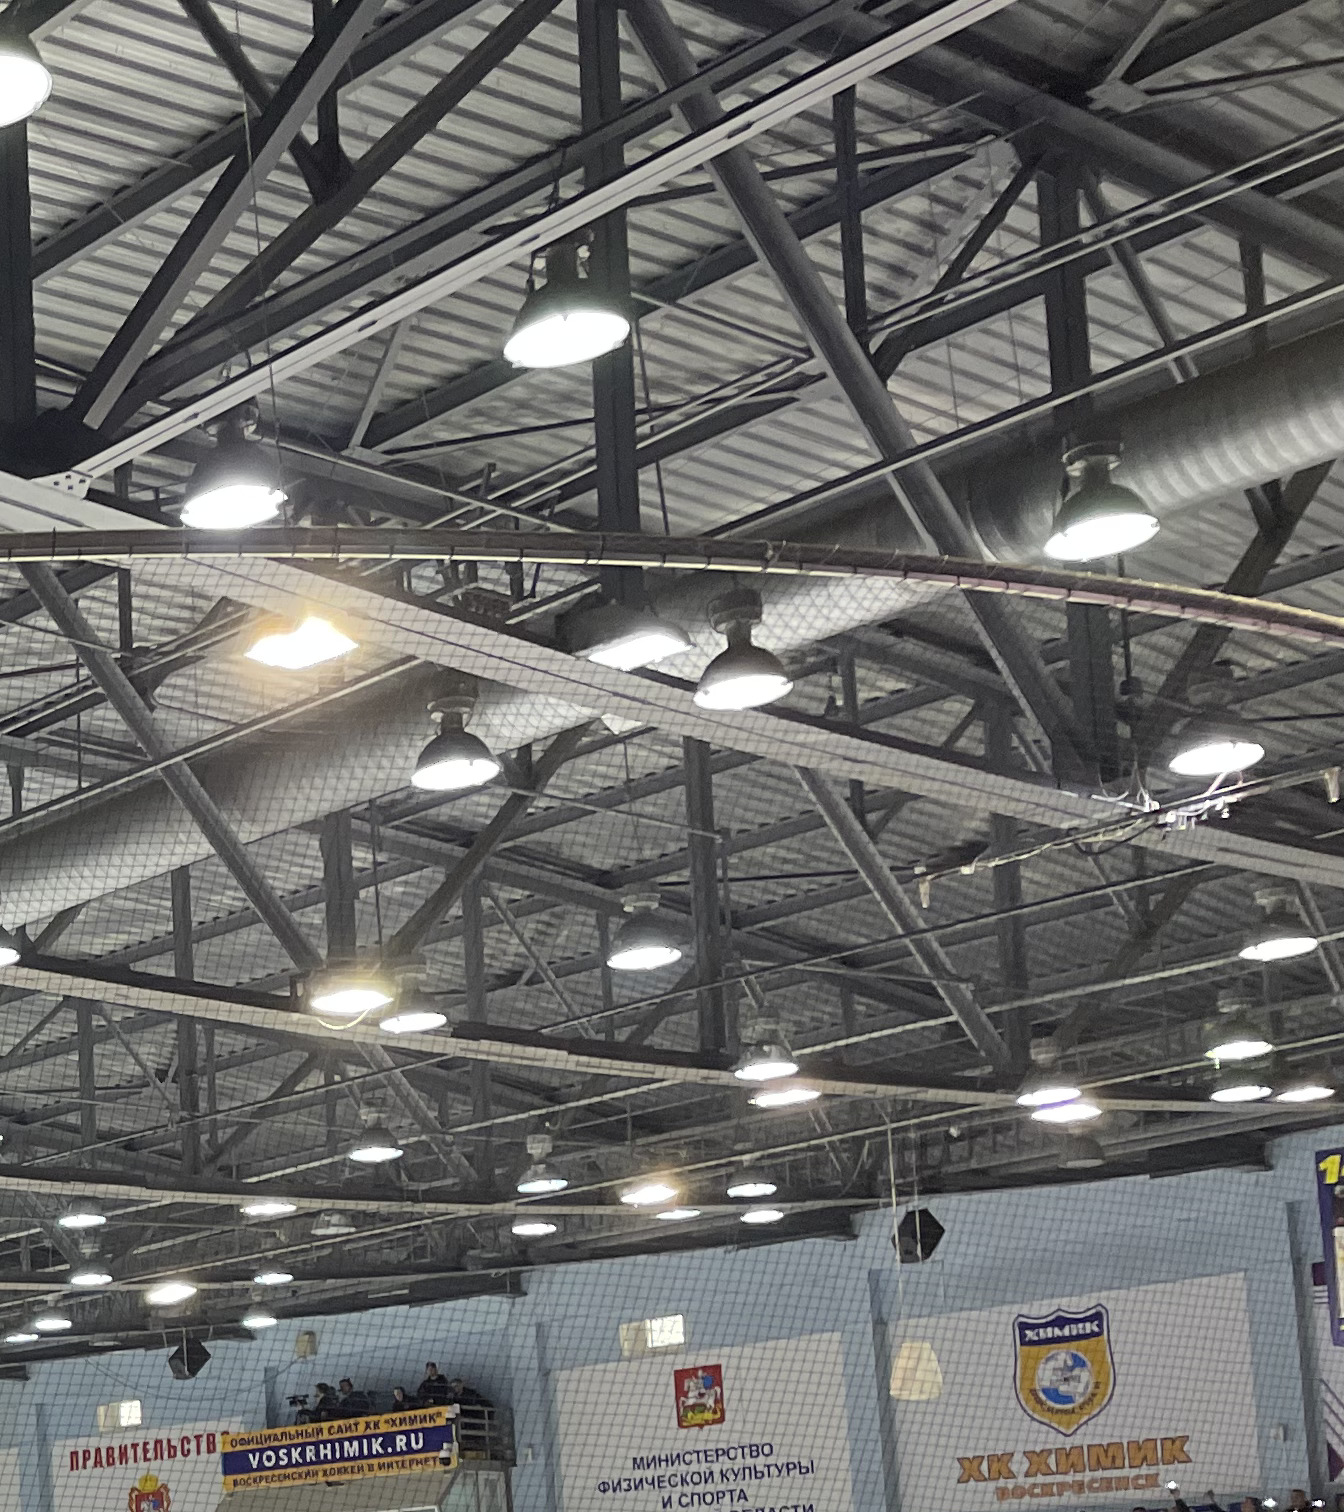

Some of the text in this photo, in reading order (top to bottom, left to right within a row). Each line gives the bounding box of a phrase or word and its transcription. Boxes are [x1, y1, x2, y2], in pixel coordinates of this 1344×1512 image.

[1024, 1320, 1100, 1341] ХИМИК
[230, 1427, 324, 1448] ОФИЦИАЛЬНЫЙ
[328, 1422, 360, 1440] САЙТ
[364, 1420, 381, 1433] ХК
[70, 1431, 229, 1471] ПРАВИТЕЛЬСТВ
[248, 1432, 424, 1469] VOSKRHIMIK.RU
[632, 1443, 774, 1471] МИНИСТЕРСТВО
[957, 1435, 1192, 1483] ХК ХИМИК
[322, 1465, 364, 1478] ХОККЕЙ
[378, 1456, 439, 1471] ИНТЕРНЕТ
[597, 1460, 815, 1494] ФИЗИЧЕСКОЙ КУЛЬТУРЫ
[662, 1489, 749, 1509] И СПОРТА
[995, 1473, 1160, 1502] ВОСКРЕСЕНСК
